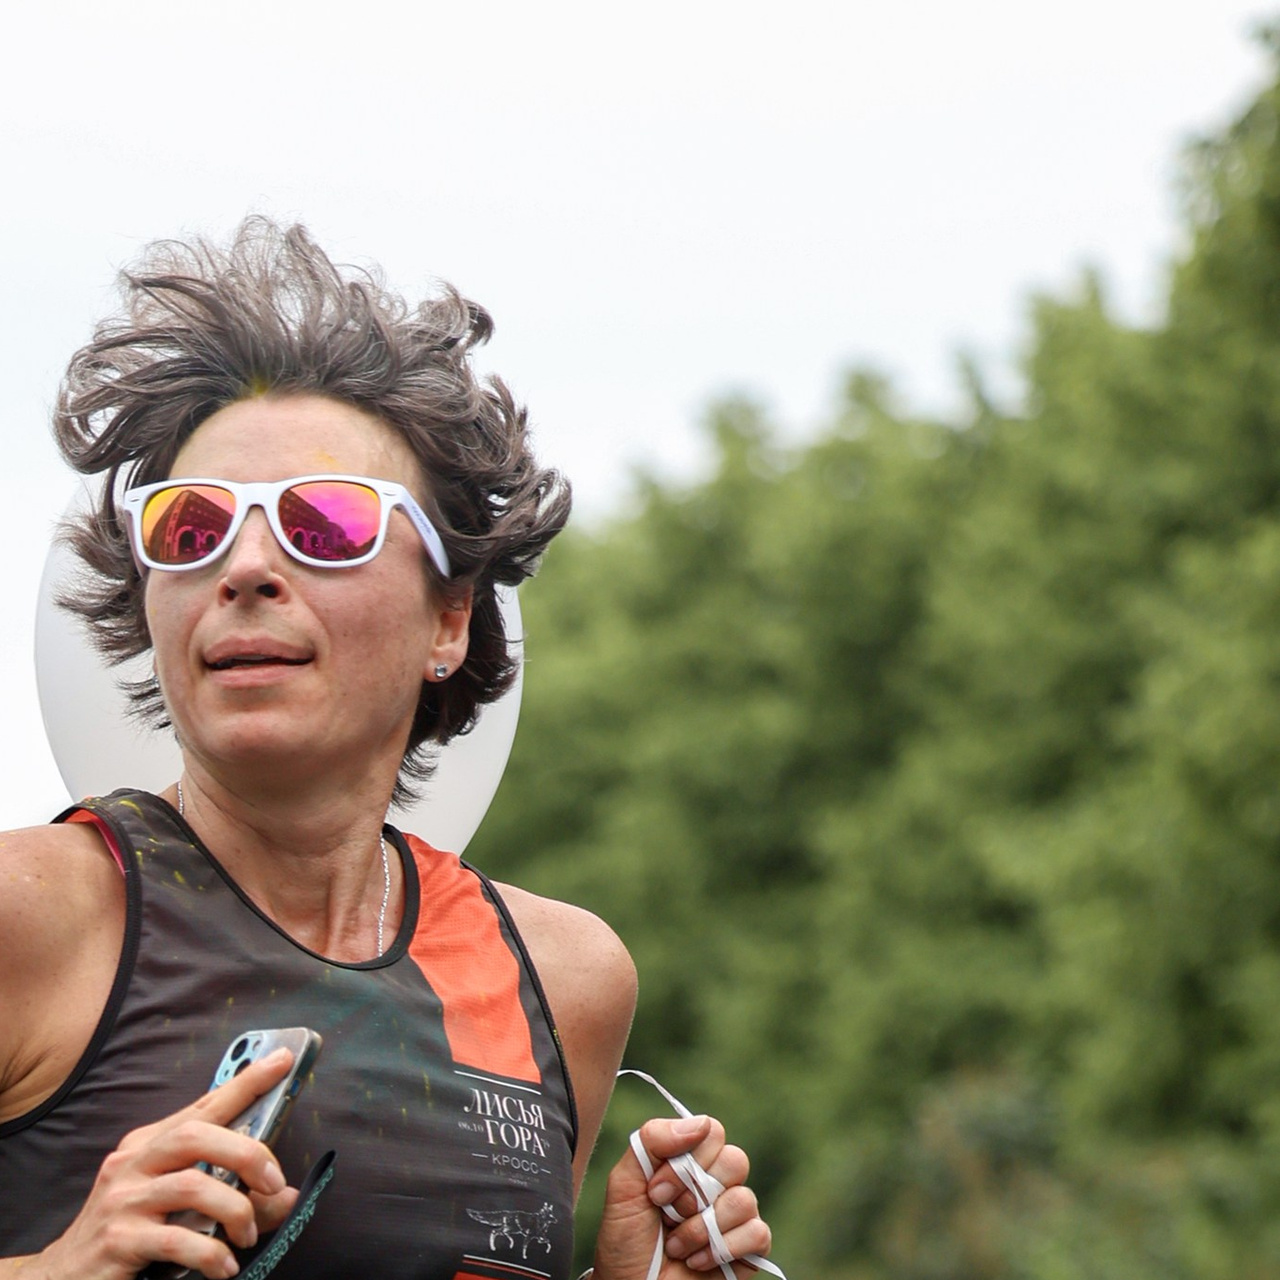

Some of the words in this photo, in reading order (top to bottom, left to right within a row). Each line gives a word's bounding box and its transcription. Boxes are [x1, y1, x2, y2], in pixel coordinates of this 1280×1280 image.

[463, 1087, 546, 1130] ЛИСЬЯ
[483, 1118, 546, 1158] ГОРА
[491, 1153, 539, 1174] КРОСС
